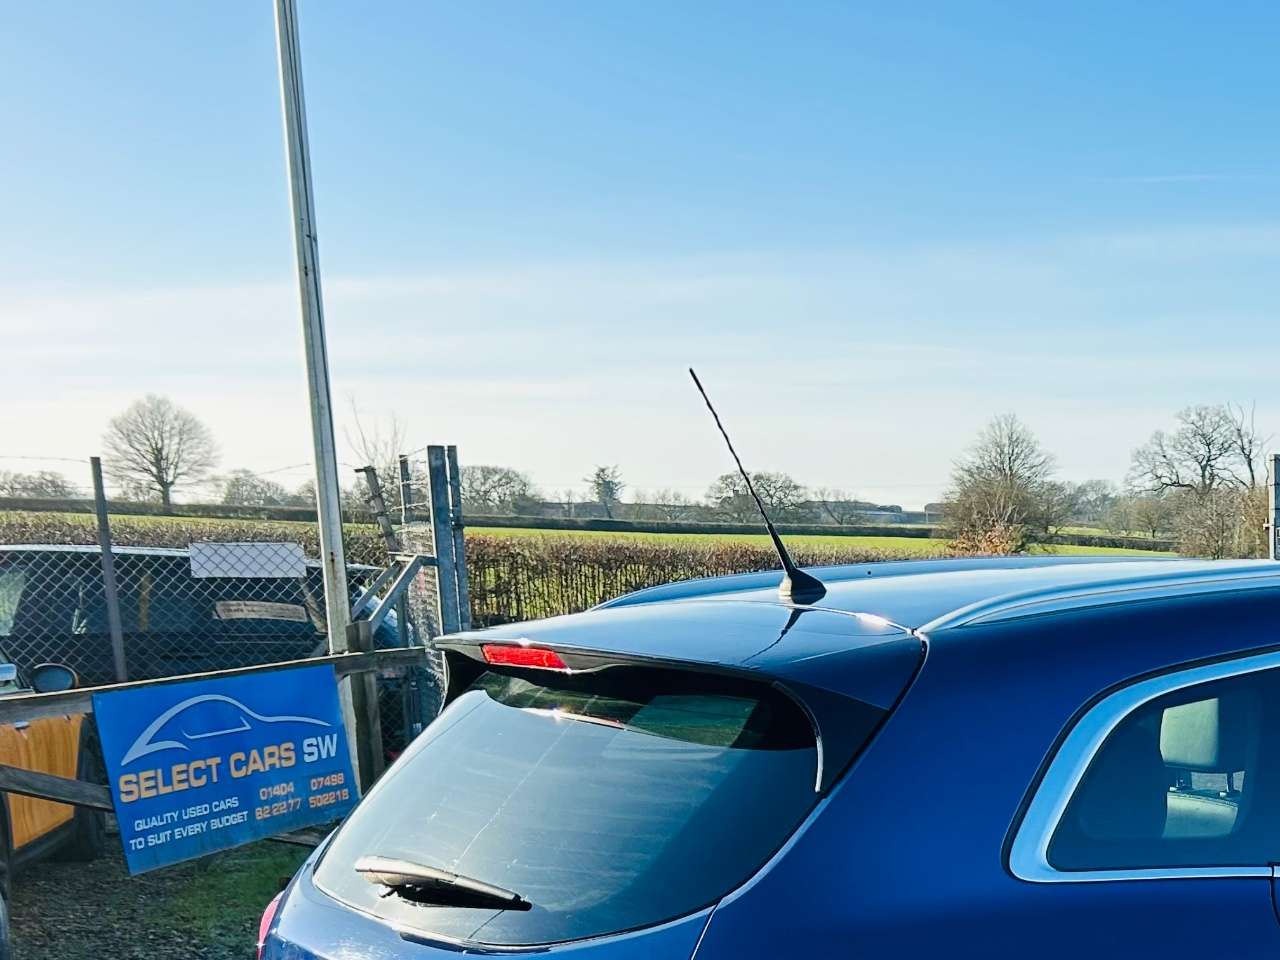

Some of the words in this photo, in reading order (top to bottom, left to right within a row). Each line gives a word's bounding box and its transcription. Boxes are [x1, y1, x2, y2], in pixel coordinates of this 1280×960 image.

[118, 757, 222, 803] SELECT
[229, 742, 296, 779] CARS
[303, 733, 337, 763] SW
[129, 837, 145, 851] TO
[147, 830, 173, 847] SUIT
[174, 820, 209, 840] EVERY
[210, 811, 249, 831] BUDGET
[134, 810, 180, 832] QUALITY
[182, 804, 210, 820] USED
[212, 797, 240, 812] CARS
